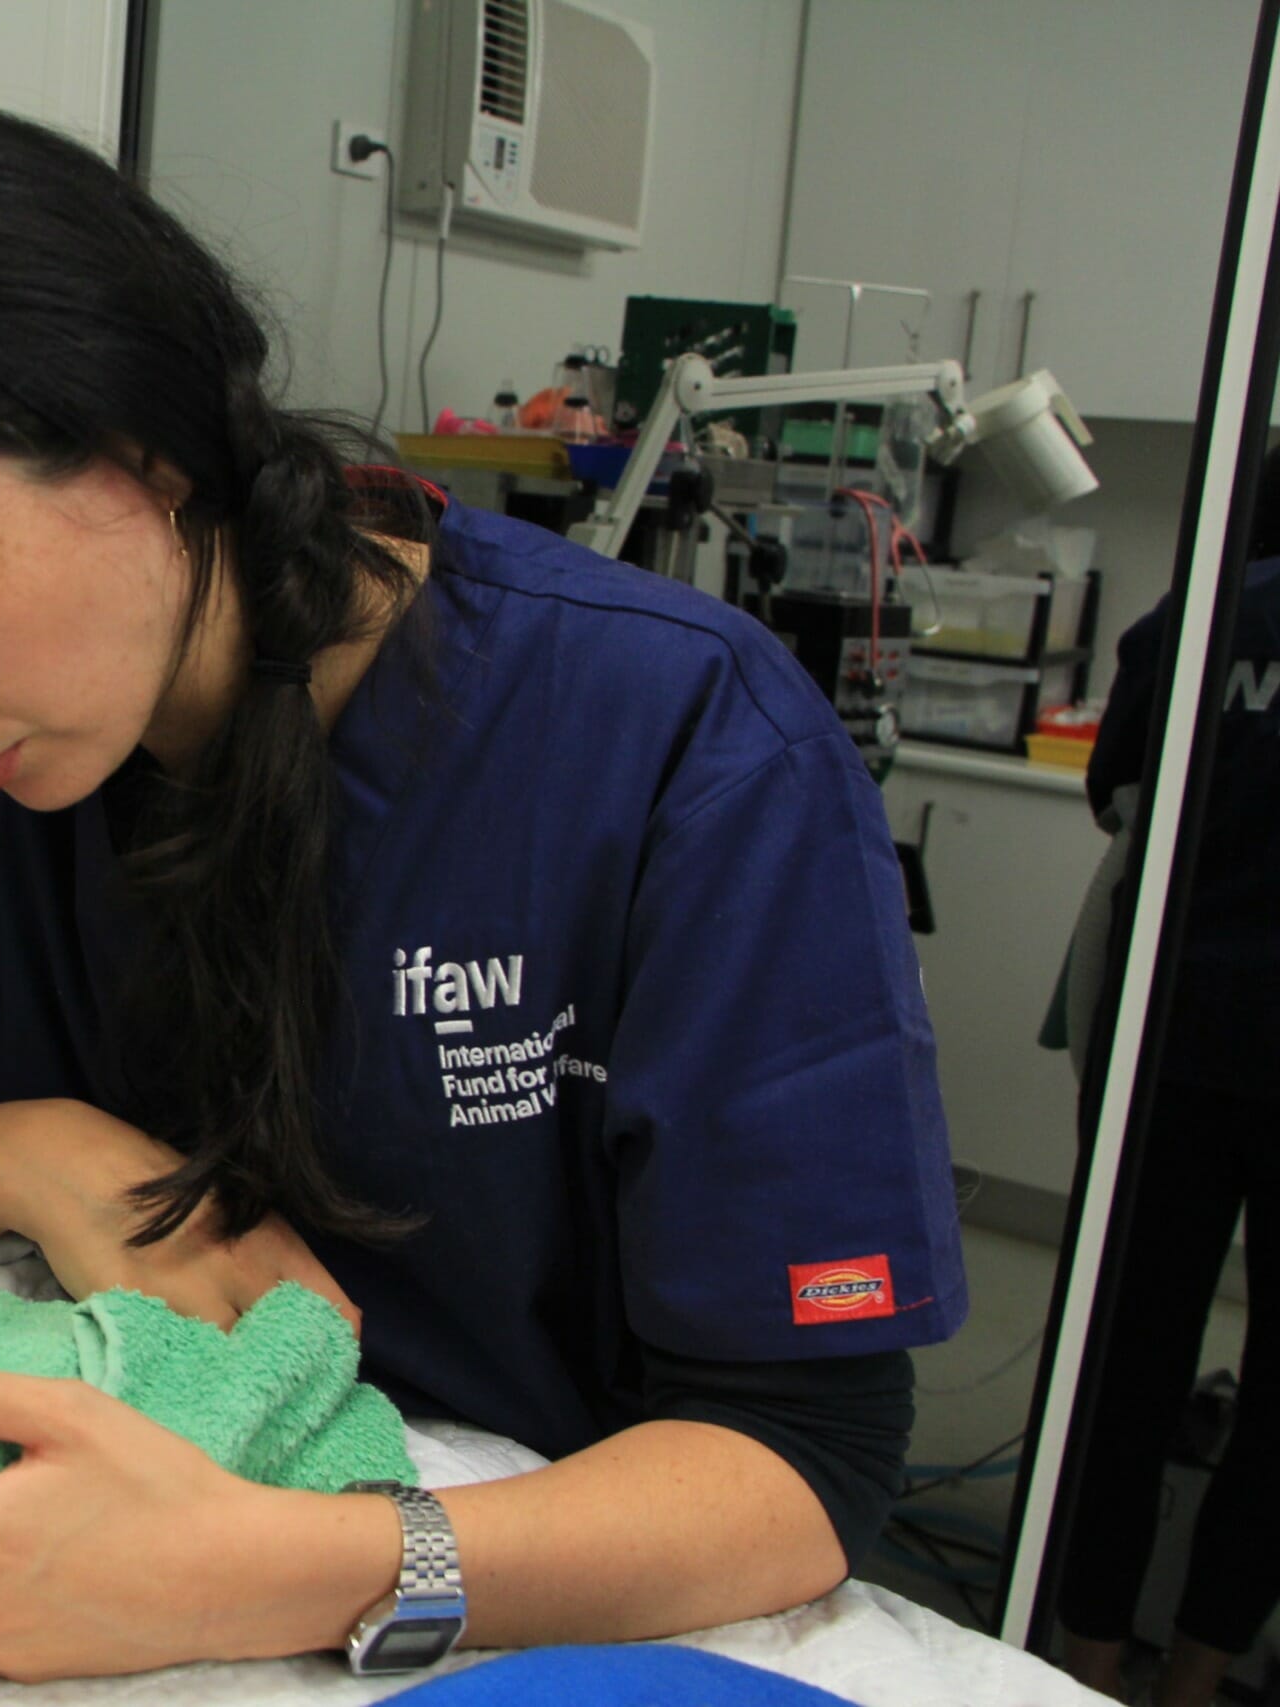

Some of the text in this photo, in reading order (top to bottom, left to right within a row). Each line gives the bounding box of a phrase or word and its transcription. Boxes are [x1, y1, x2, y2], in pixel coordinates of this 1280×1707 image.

[392, 945, 524, 1017] ifaw
[437, 1003, 576, 1069] Internatioal
[442, 1066, 548, 1099] Fund for
[450, 1092, 543, 1128] Animal
[804, 1282, 878, 1298] Dickies
